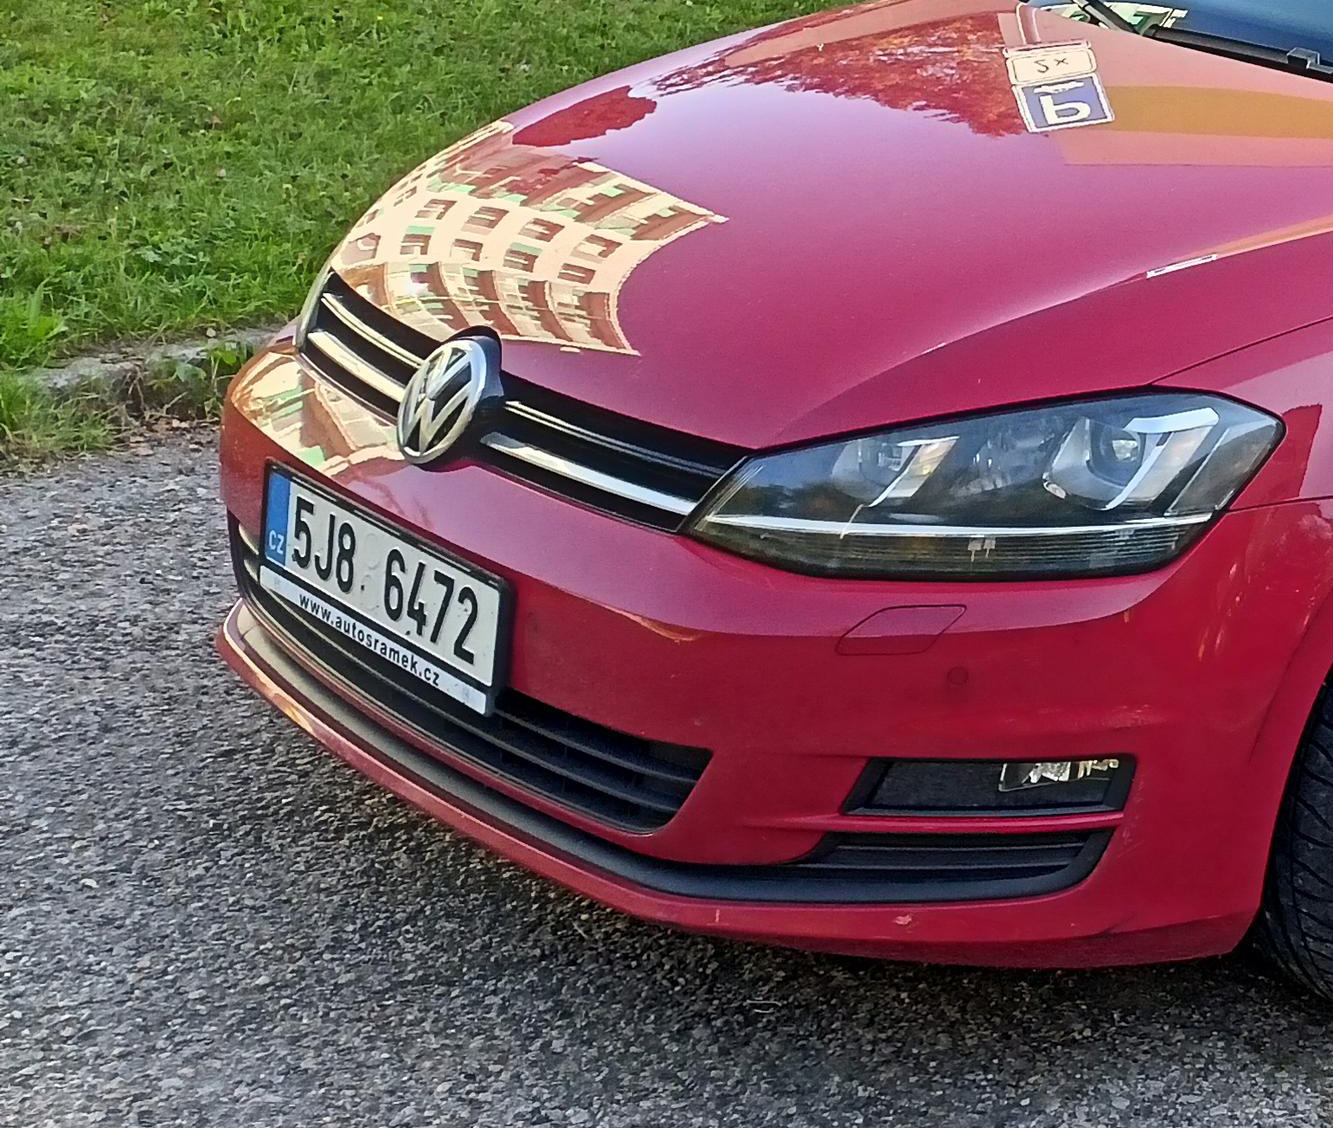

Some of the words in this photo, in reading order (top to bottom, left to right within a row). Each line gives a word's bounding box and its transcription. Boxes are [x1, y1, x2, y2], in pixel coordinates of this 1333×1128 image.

[268, 530, 285, 554] CZ
[291, 495, 357, 593] 5J8
[384, 549, 479, 665] 6472
[299, 593, 440, 687] www.autosramek.cz
